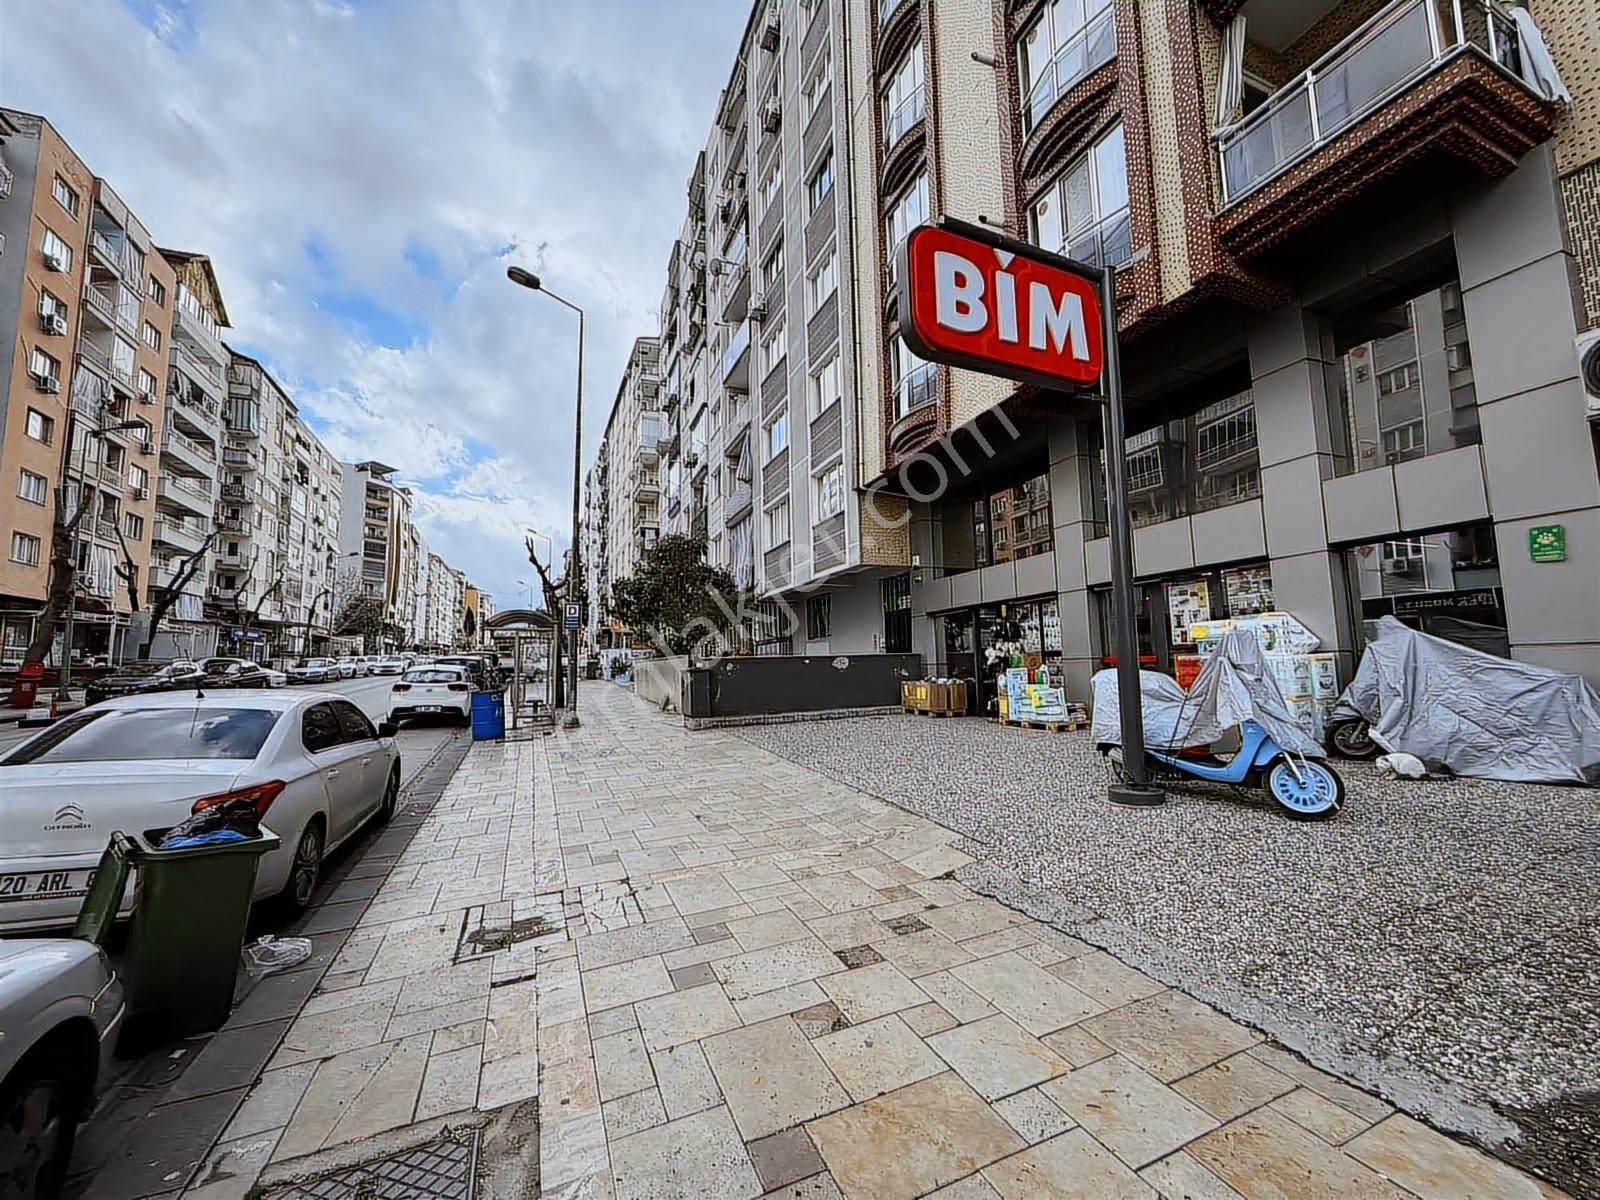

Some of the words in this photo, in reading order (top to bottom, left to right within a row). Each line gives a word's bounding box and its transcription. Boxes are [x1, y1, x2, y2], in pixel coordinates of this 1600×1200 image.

[934, 247, 1090, 361] BİM
[1, 875, 27, 895] 20
[36, 872, 73, 892] ARL
